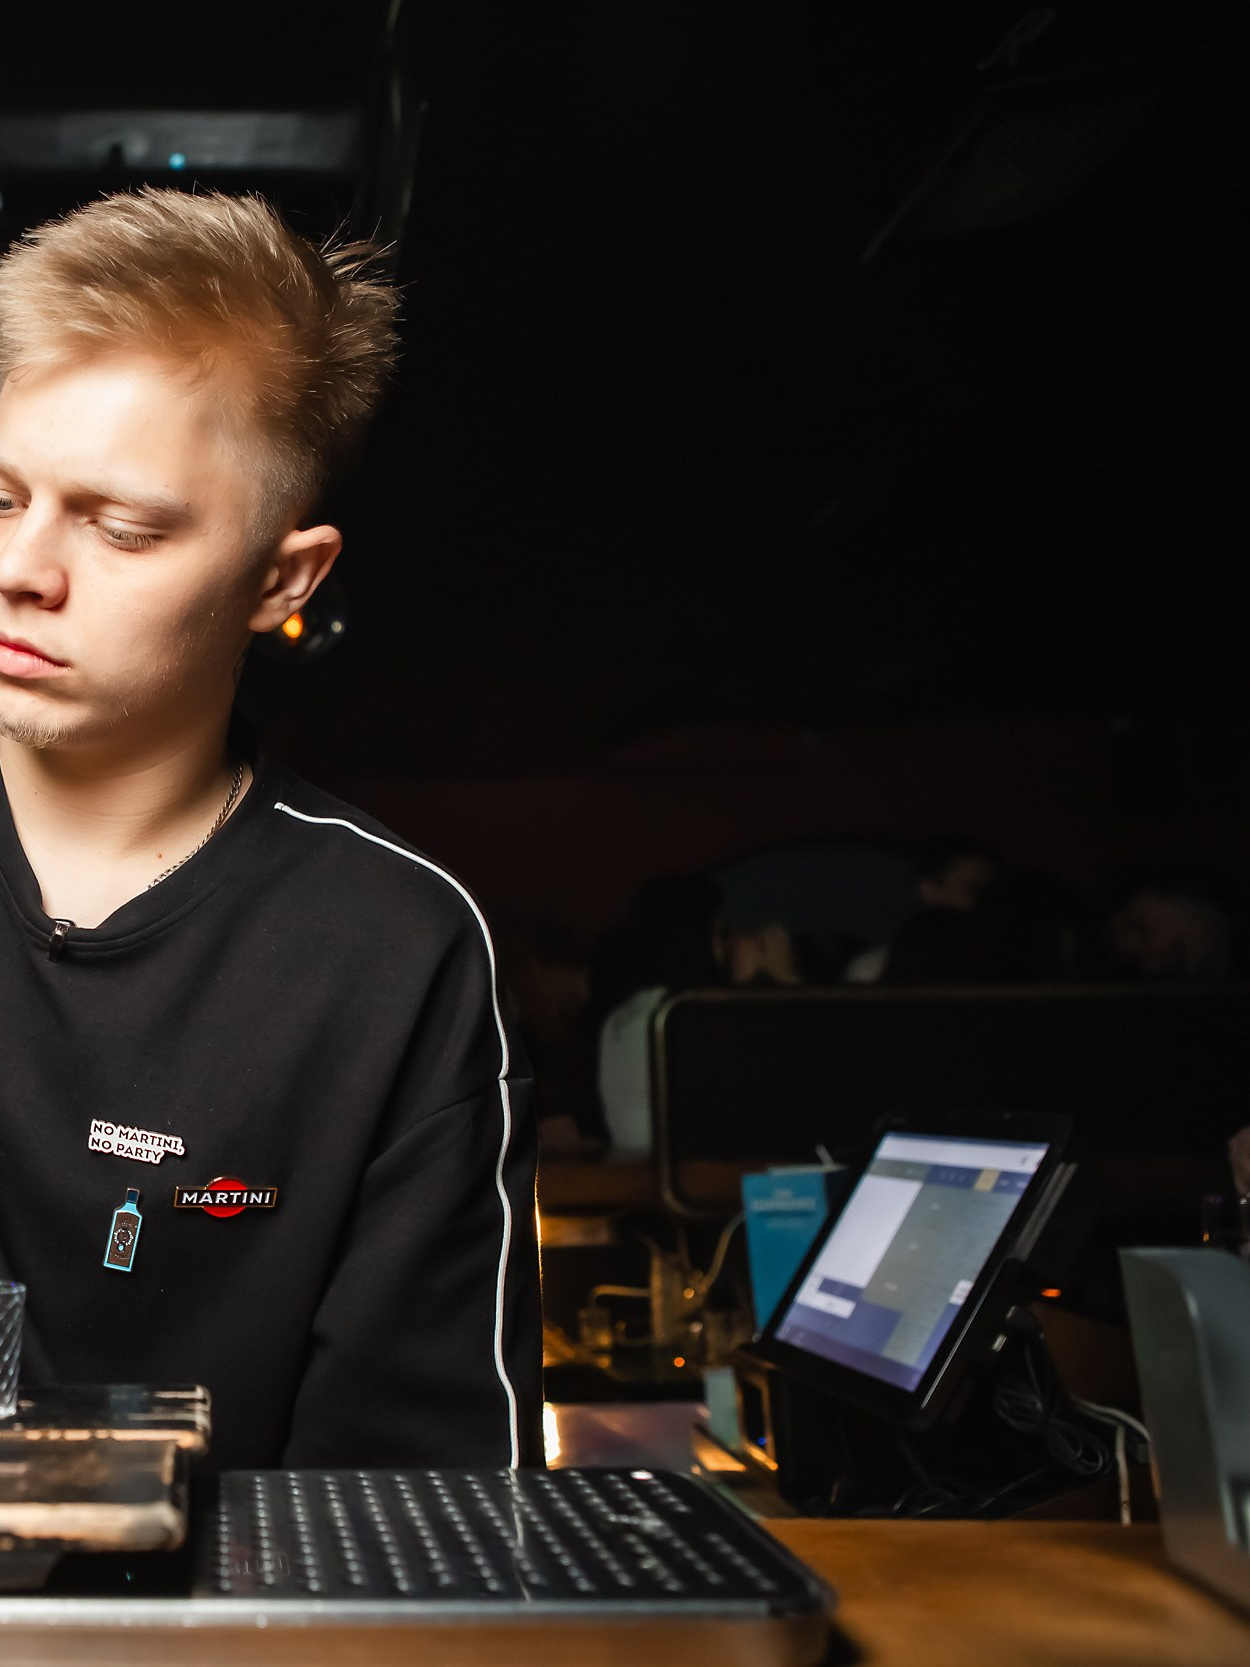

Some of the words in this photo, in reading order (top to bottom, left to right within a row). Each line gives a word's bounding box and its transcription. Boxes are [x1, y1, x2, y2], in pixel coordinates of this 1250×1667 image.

[91, 1137, 112, 1150] NO
[116, 1142, 161, 1161] PARTY
[93, 1123, 114, 1136] NO
[118, 1128, 182, 1152] MARTINI,
[181, 1191, 271, 1204] MARTINI
